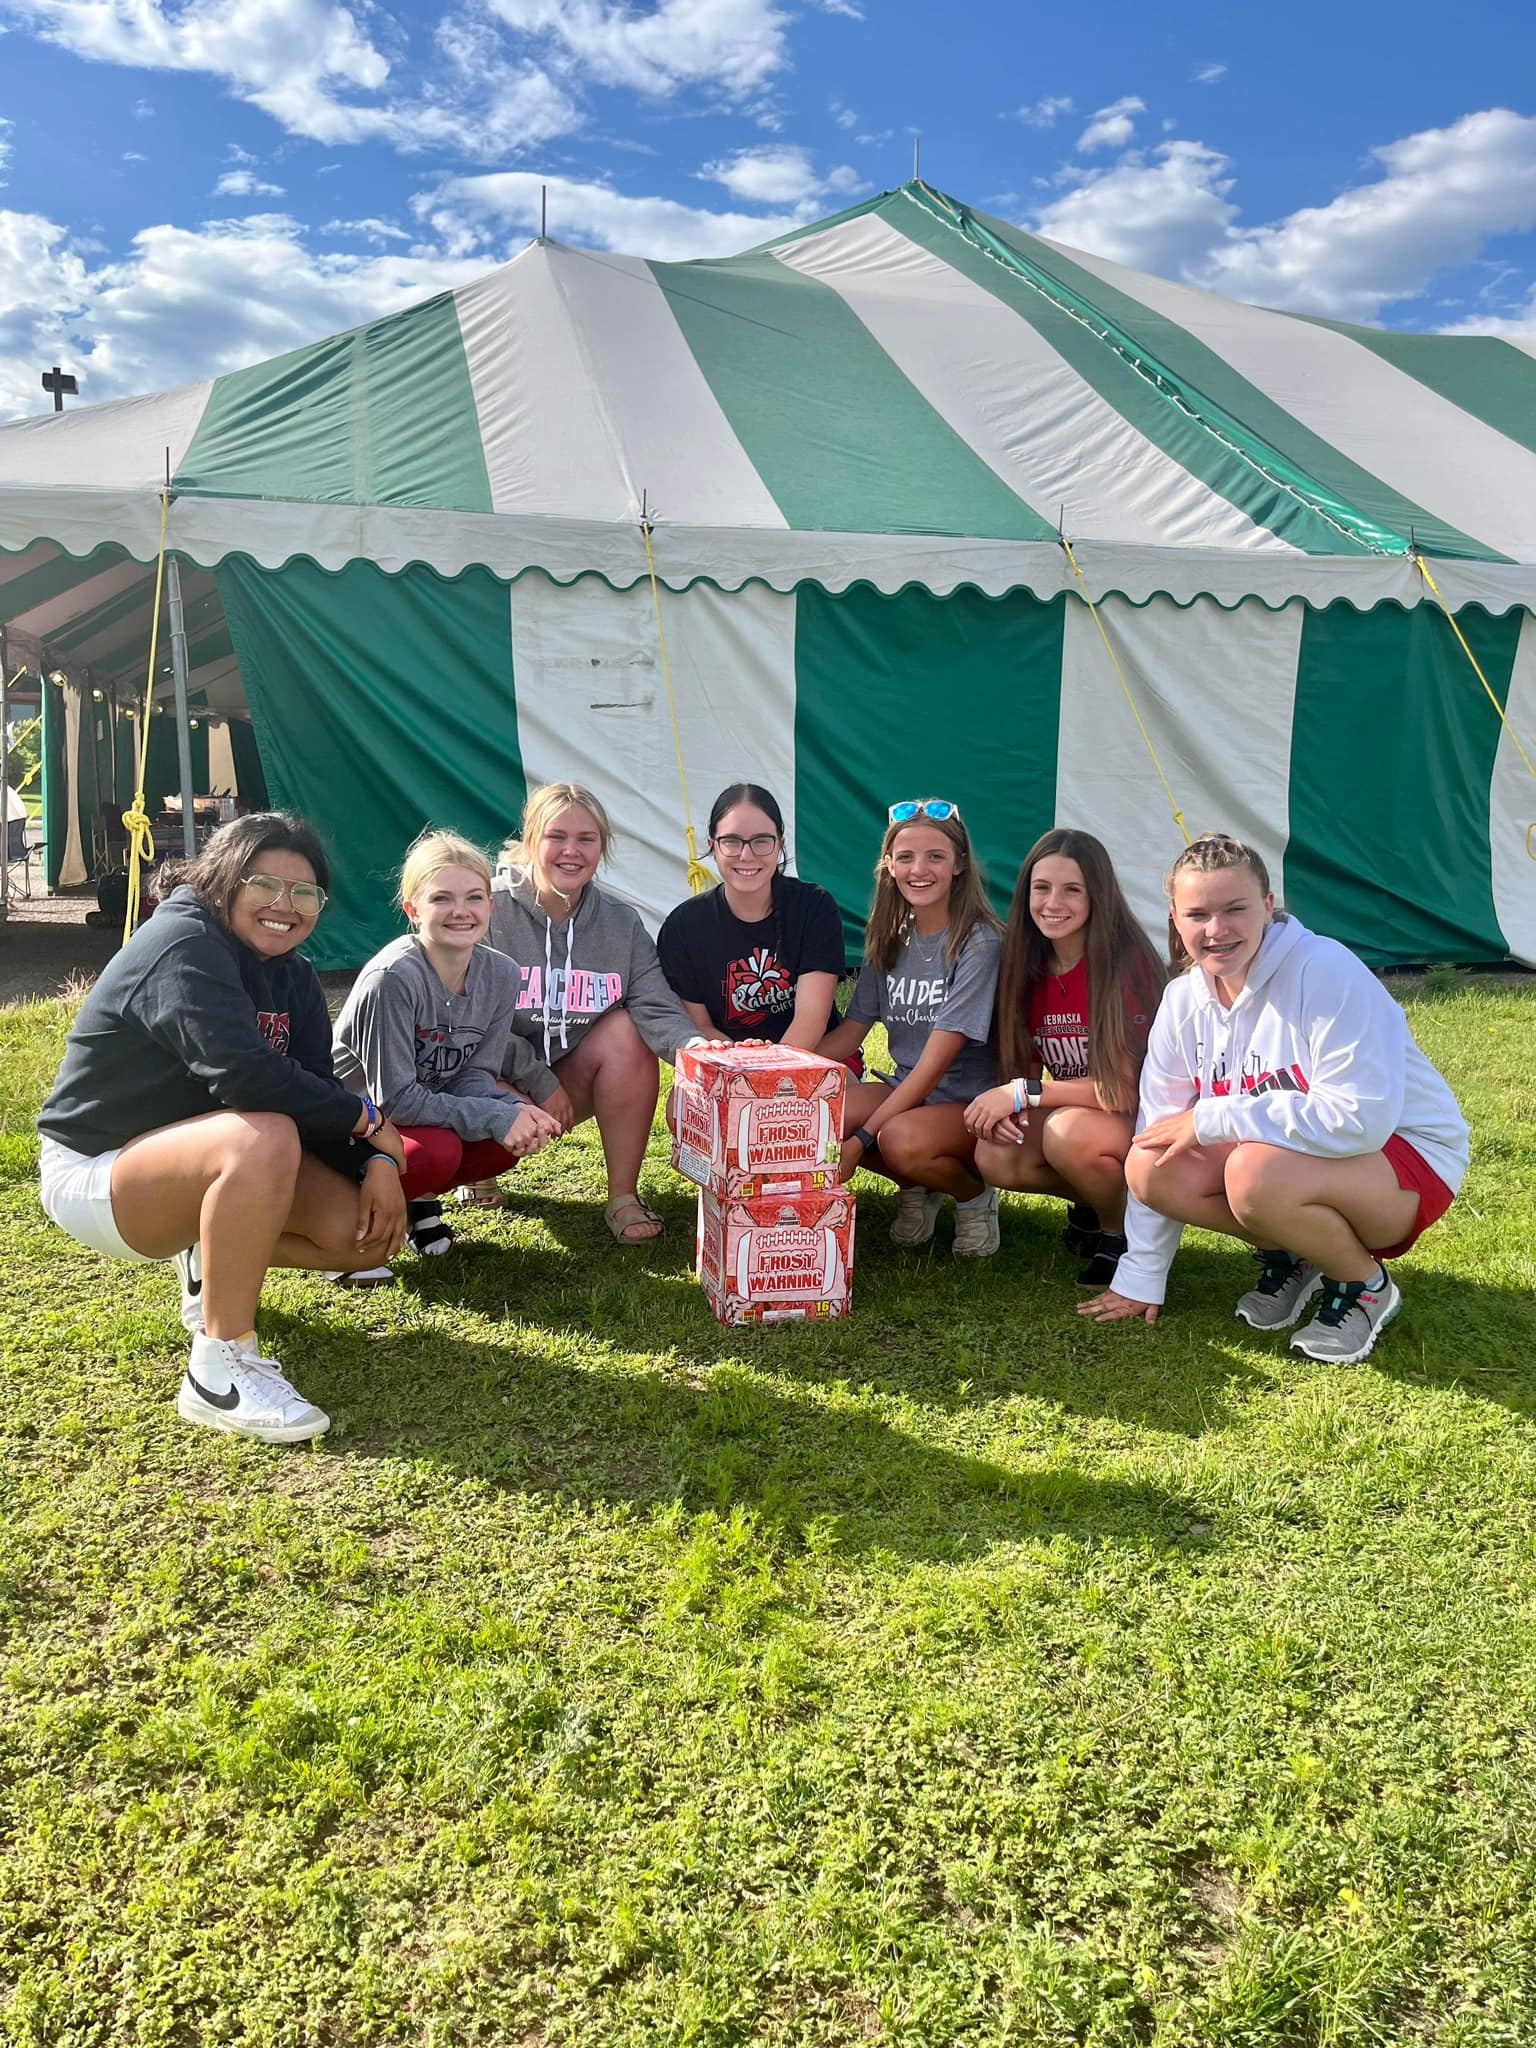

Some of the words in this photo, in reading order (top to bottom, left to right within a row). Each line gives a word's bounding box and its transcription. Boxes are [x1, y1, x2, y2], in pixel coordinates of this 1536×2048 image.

[758, 1120, 811, 1144] FROST
[749, 1141, 817, 1165] WARNING
[812, 1171, 825, 1183] 16
[759, 1249, 817, 1272] FROST
[749, 1269, 824, 1293] WARNING
[816, 1301, 830, 1312] 16
